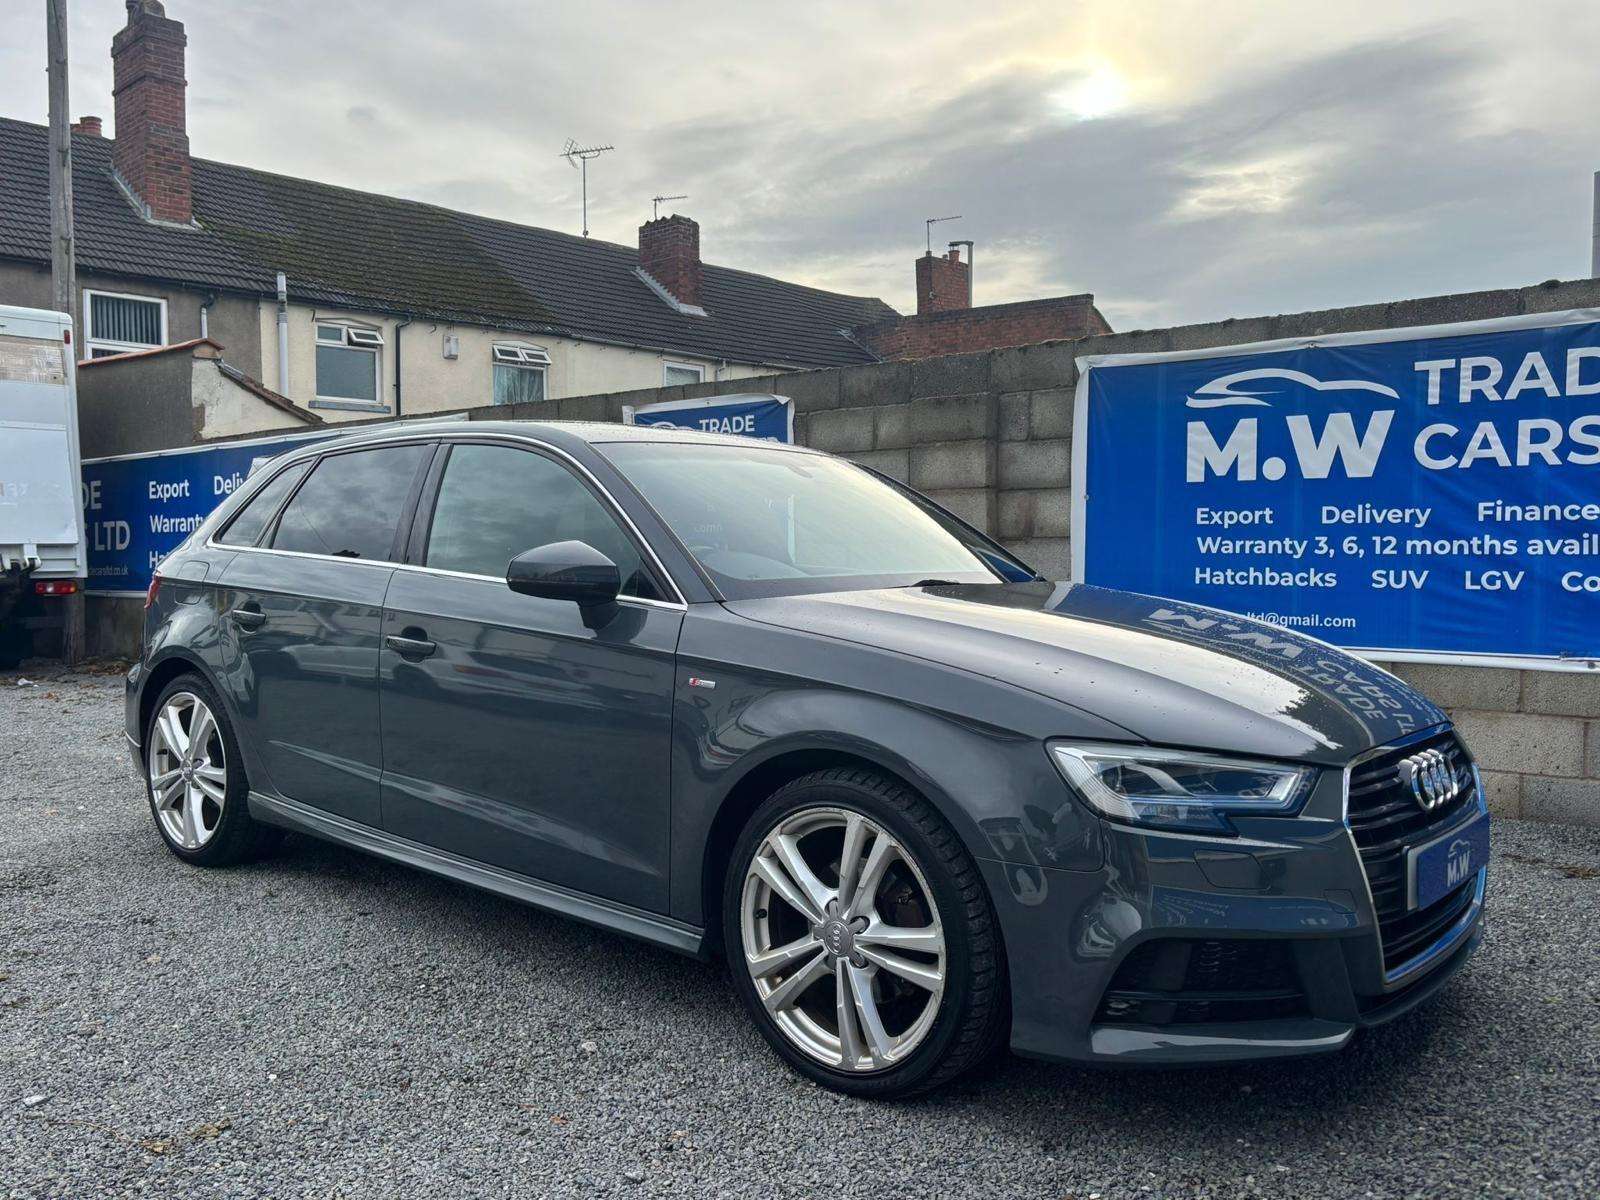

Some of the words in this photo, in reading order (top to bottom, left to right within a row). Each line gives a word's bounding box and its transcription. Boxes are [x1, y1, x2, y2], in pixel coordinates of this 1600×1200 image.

[1414, 346, 1600, 405] TRAD
[699, 414, 755, 434] TRADE
[1186, 409, 1395, 483] M.W
[1413, 414, 1600, 470] CARS
[149, 479, 190, 502] Export
[149, 513, 203, 533] Warrant
[1196, 506, 1274, 529] Export
[1321, 503, 1432, 528] Delivery
[1477, 499, 1600, 522] Finance
[95, 520, 131, 551] LTD
[1196, 536, 1308, 559] Warranty
[1314, 536, 1335, 558] 3,
[1342, 536, 1365, 558] 6,
[1372, 536, 1397, 555] 12
[1406, 534, 1518, 555] months
[1526, 532, 1599, 555] avail
[1195, 567, 1337, 587] Hatchbacks
[1371, 569, 1429, 590] SUV
[1465, 570, 1525, 591] LGV
[1561, 571, 1600, 592] Co
[1447, 853, 1470, 887] M.W
